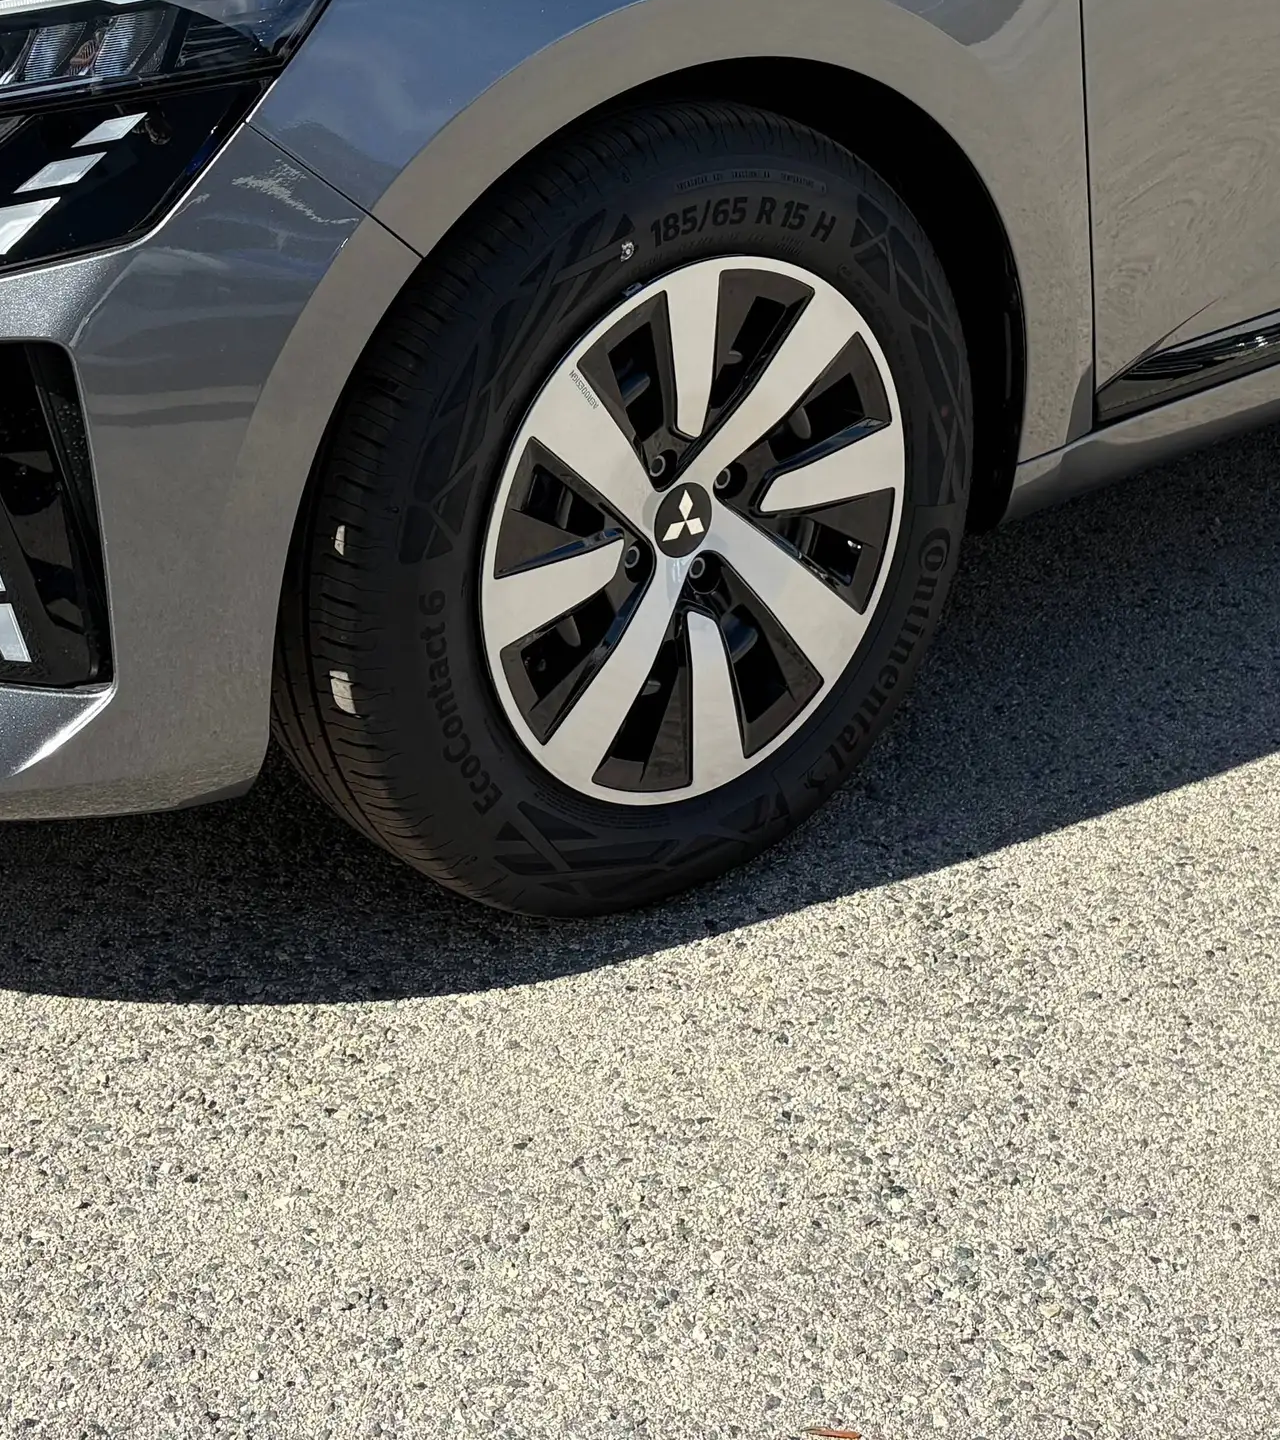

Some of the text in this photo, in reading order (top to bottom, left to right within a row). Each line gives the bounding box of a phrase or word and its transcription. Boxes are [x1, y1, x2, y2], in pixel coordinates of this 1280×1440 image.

[650, 196, 748, 248] 185/65
[755, 196, 778, 225] R
[780, 199, 810, 231] 15
[810, 211, 837, 242] H
[418, 589, 504, 817] EcoContact 6
[823, 526, 951, 776] Continental
